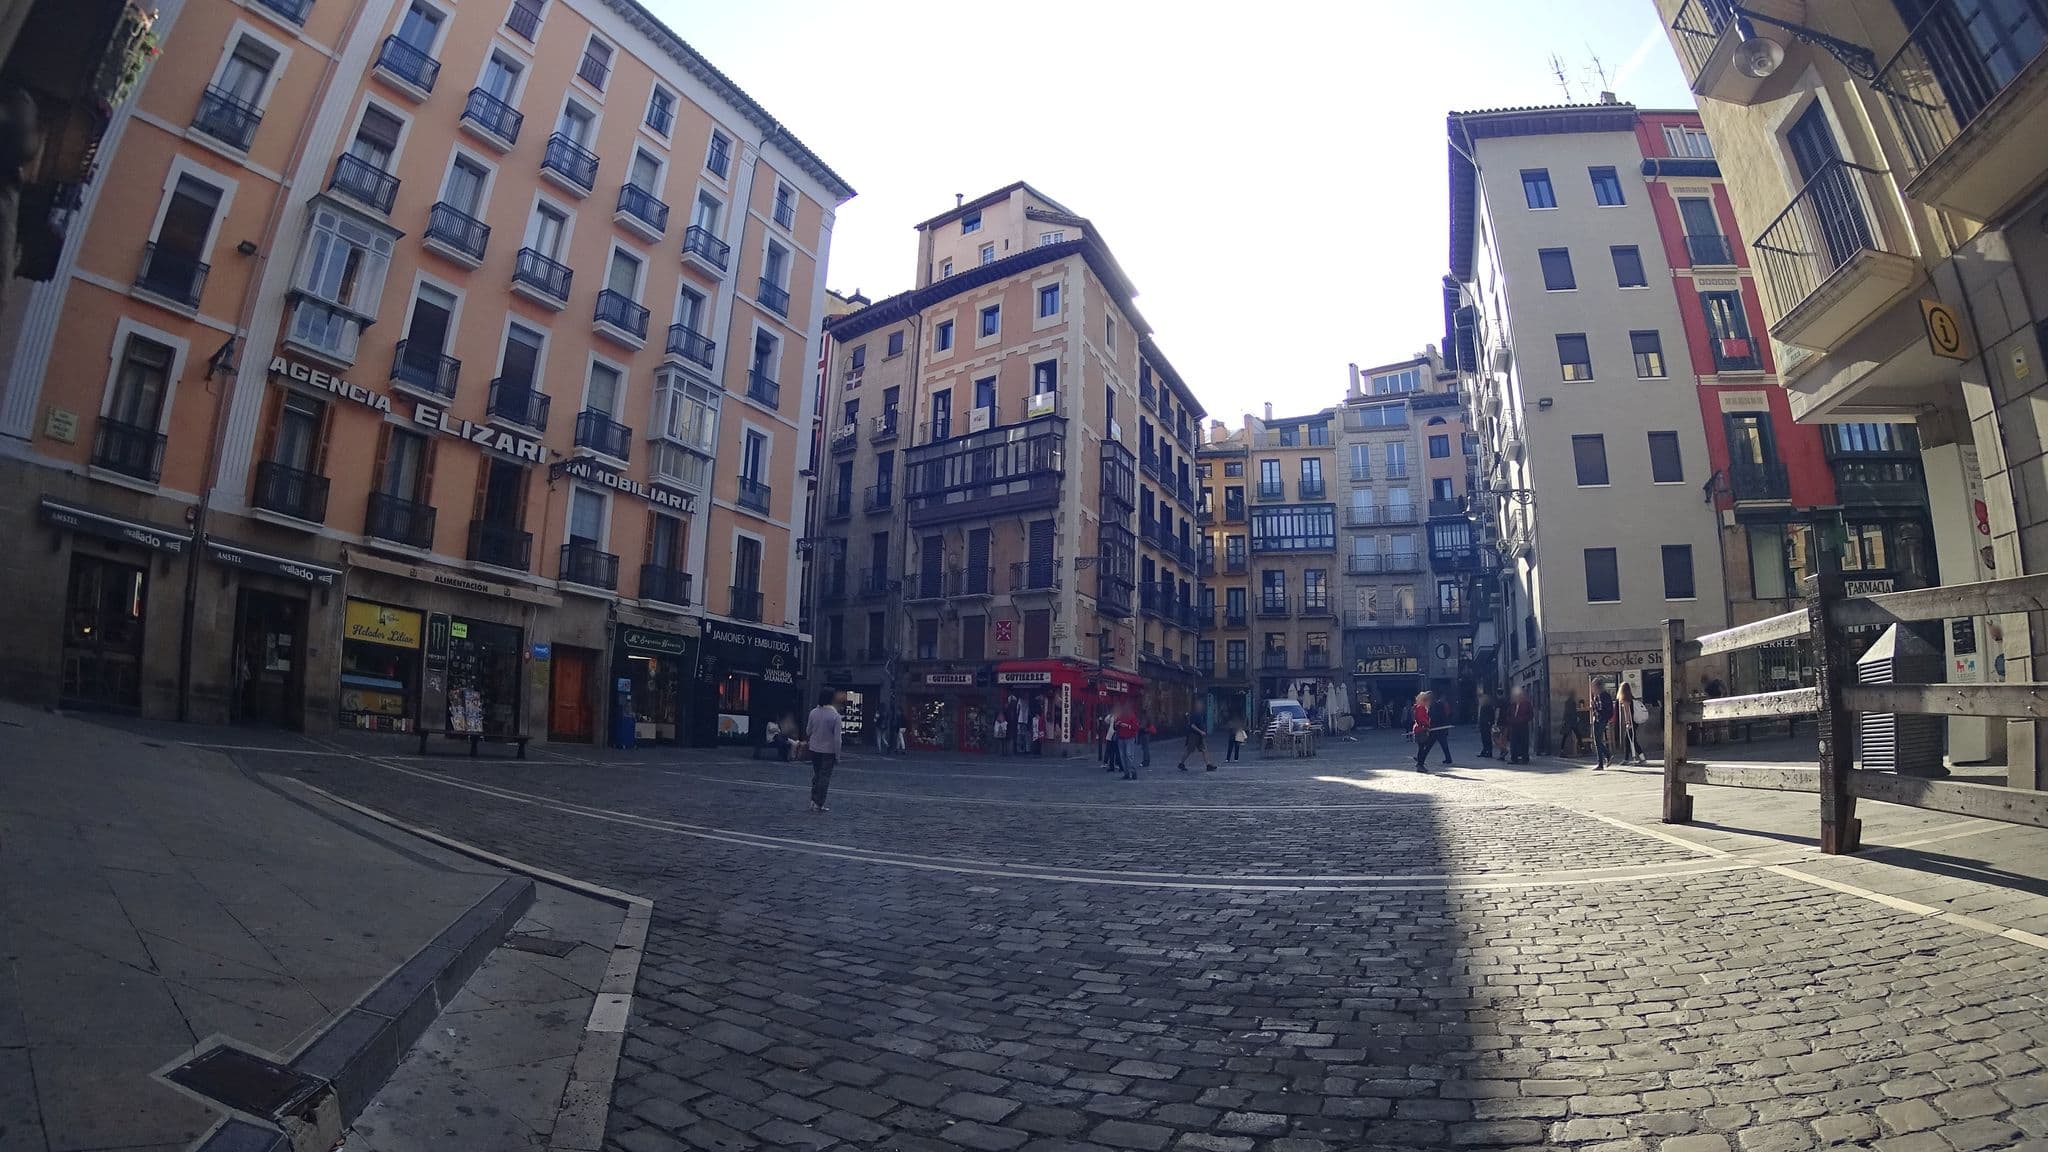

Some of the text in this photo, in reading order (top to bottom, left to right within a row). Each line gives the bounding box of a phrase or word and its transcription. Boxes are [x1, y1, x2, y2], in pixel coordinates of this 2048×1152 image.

[268, 356, 392, 413] AGENCIA
[413, 402, 548, 464] ELIZARI
[52, 513, 79, 526] AMSTEL
[217, 551, 242, 564] AMSTEL
[712, 630, 791, 652] JAMONES Y EMBUTIDOS
[1366, 644, 1407, 657] MALTEA
[1573, 652, 1663, 667] The Cookie Sh
[1005, 673, 1045, 682] GUTIERREZ
